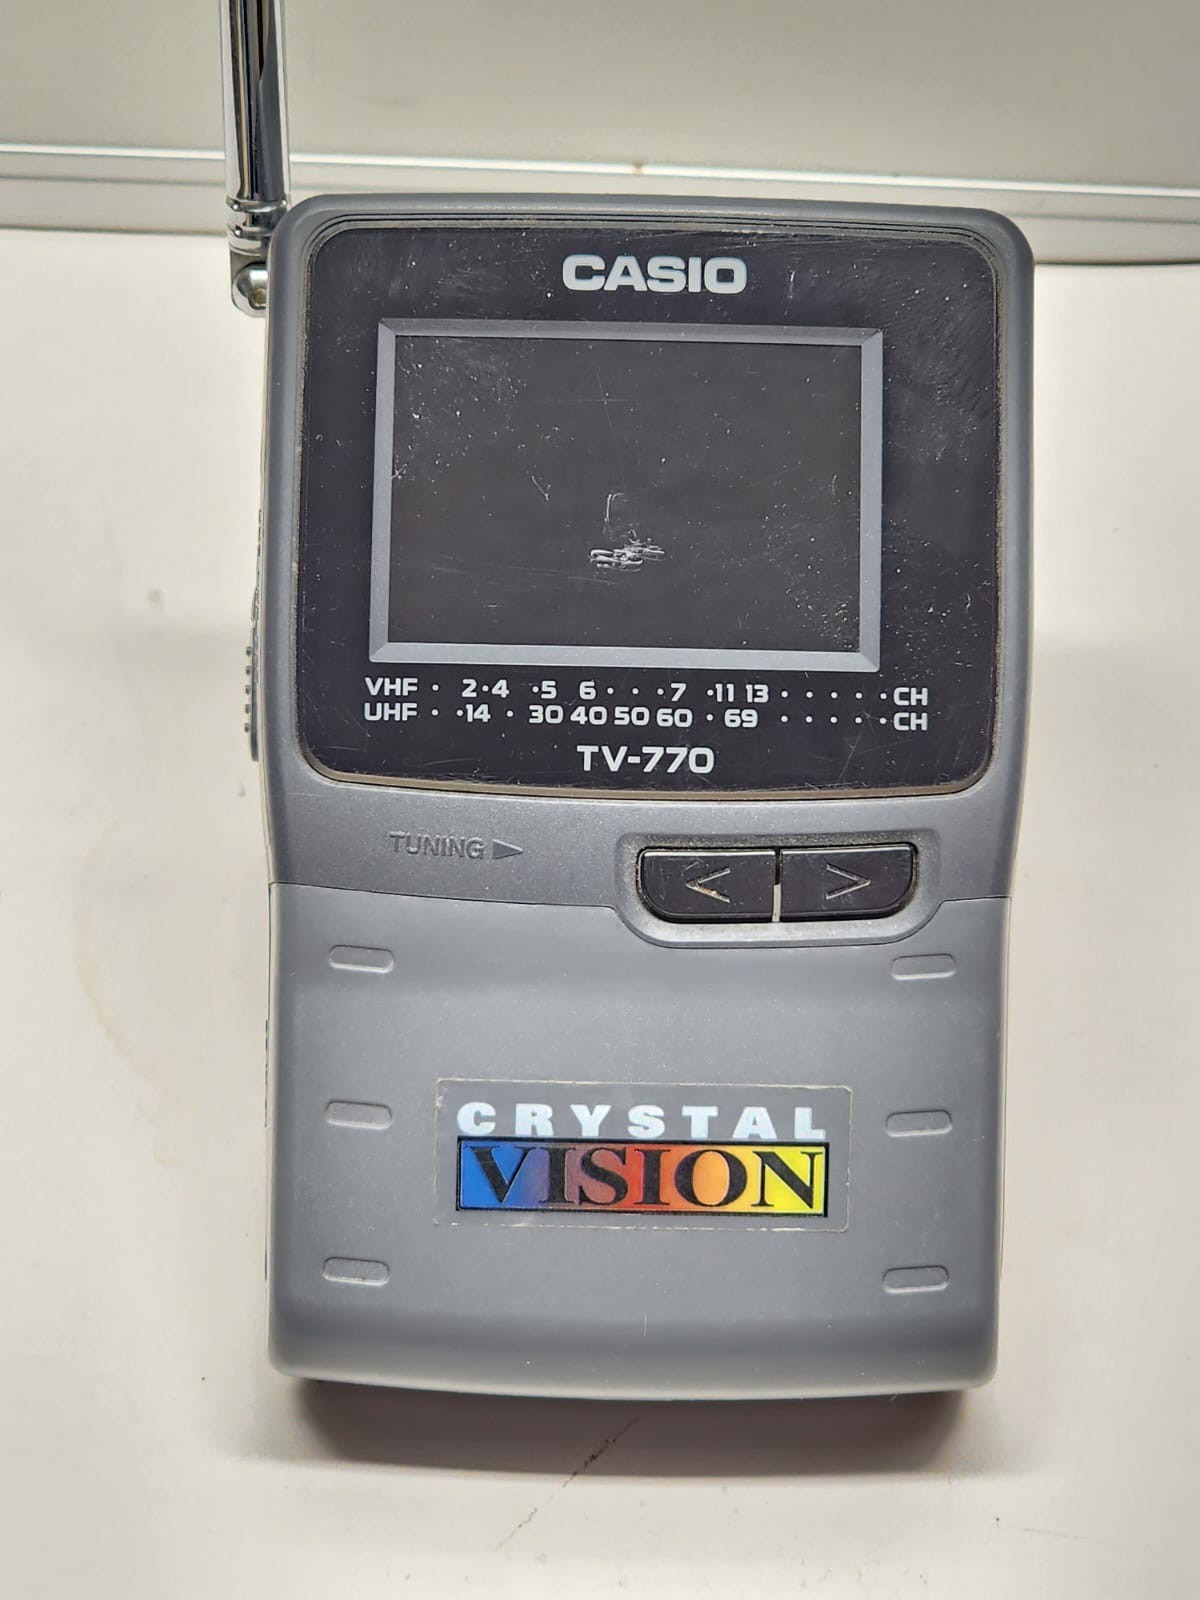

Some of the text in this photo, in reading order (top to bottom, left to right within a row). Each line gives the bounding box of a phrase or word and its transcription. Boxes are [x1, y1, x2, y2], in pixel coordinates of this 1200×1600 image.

[562, 254, 748, 294] CASIO
[364, 677, 418, 696] VHF
[579, 681, 596, 700] 6
[744, 684, 769, 703] 13
[893, 687, 928, 706] CH
[364, 702, 418, 721] UHF
[528, 704, 564, 724] 30
[570, 706, 608, 725] 40
[614, 706, 650, 726] 50
[656, 708, 693, 727] 60
[724, 709, 758, 728] 69
[893, 712, 928, 731] CH
[576, 745, 715, 774] TV-770
[389, 831, 484, 859] TUNING
[456, 1101, 826, 1140] CRYSTAL
[464, 1145, 824, 1210] VISION
